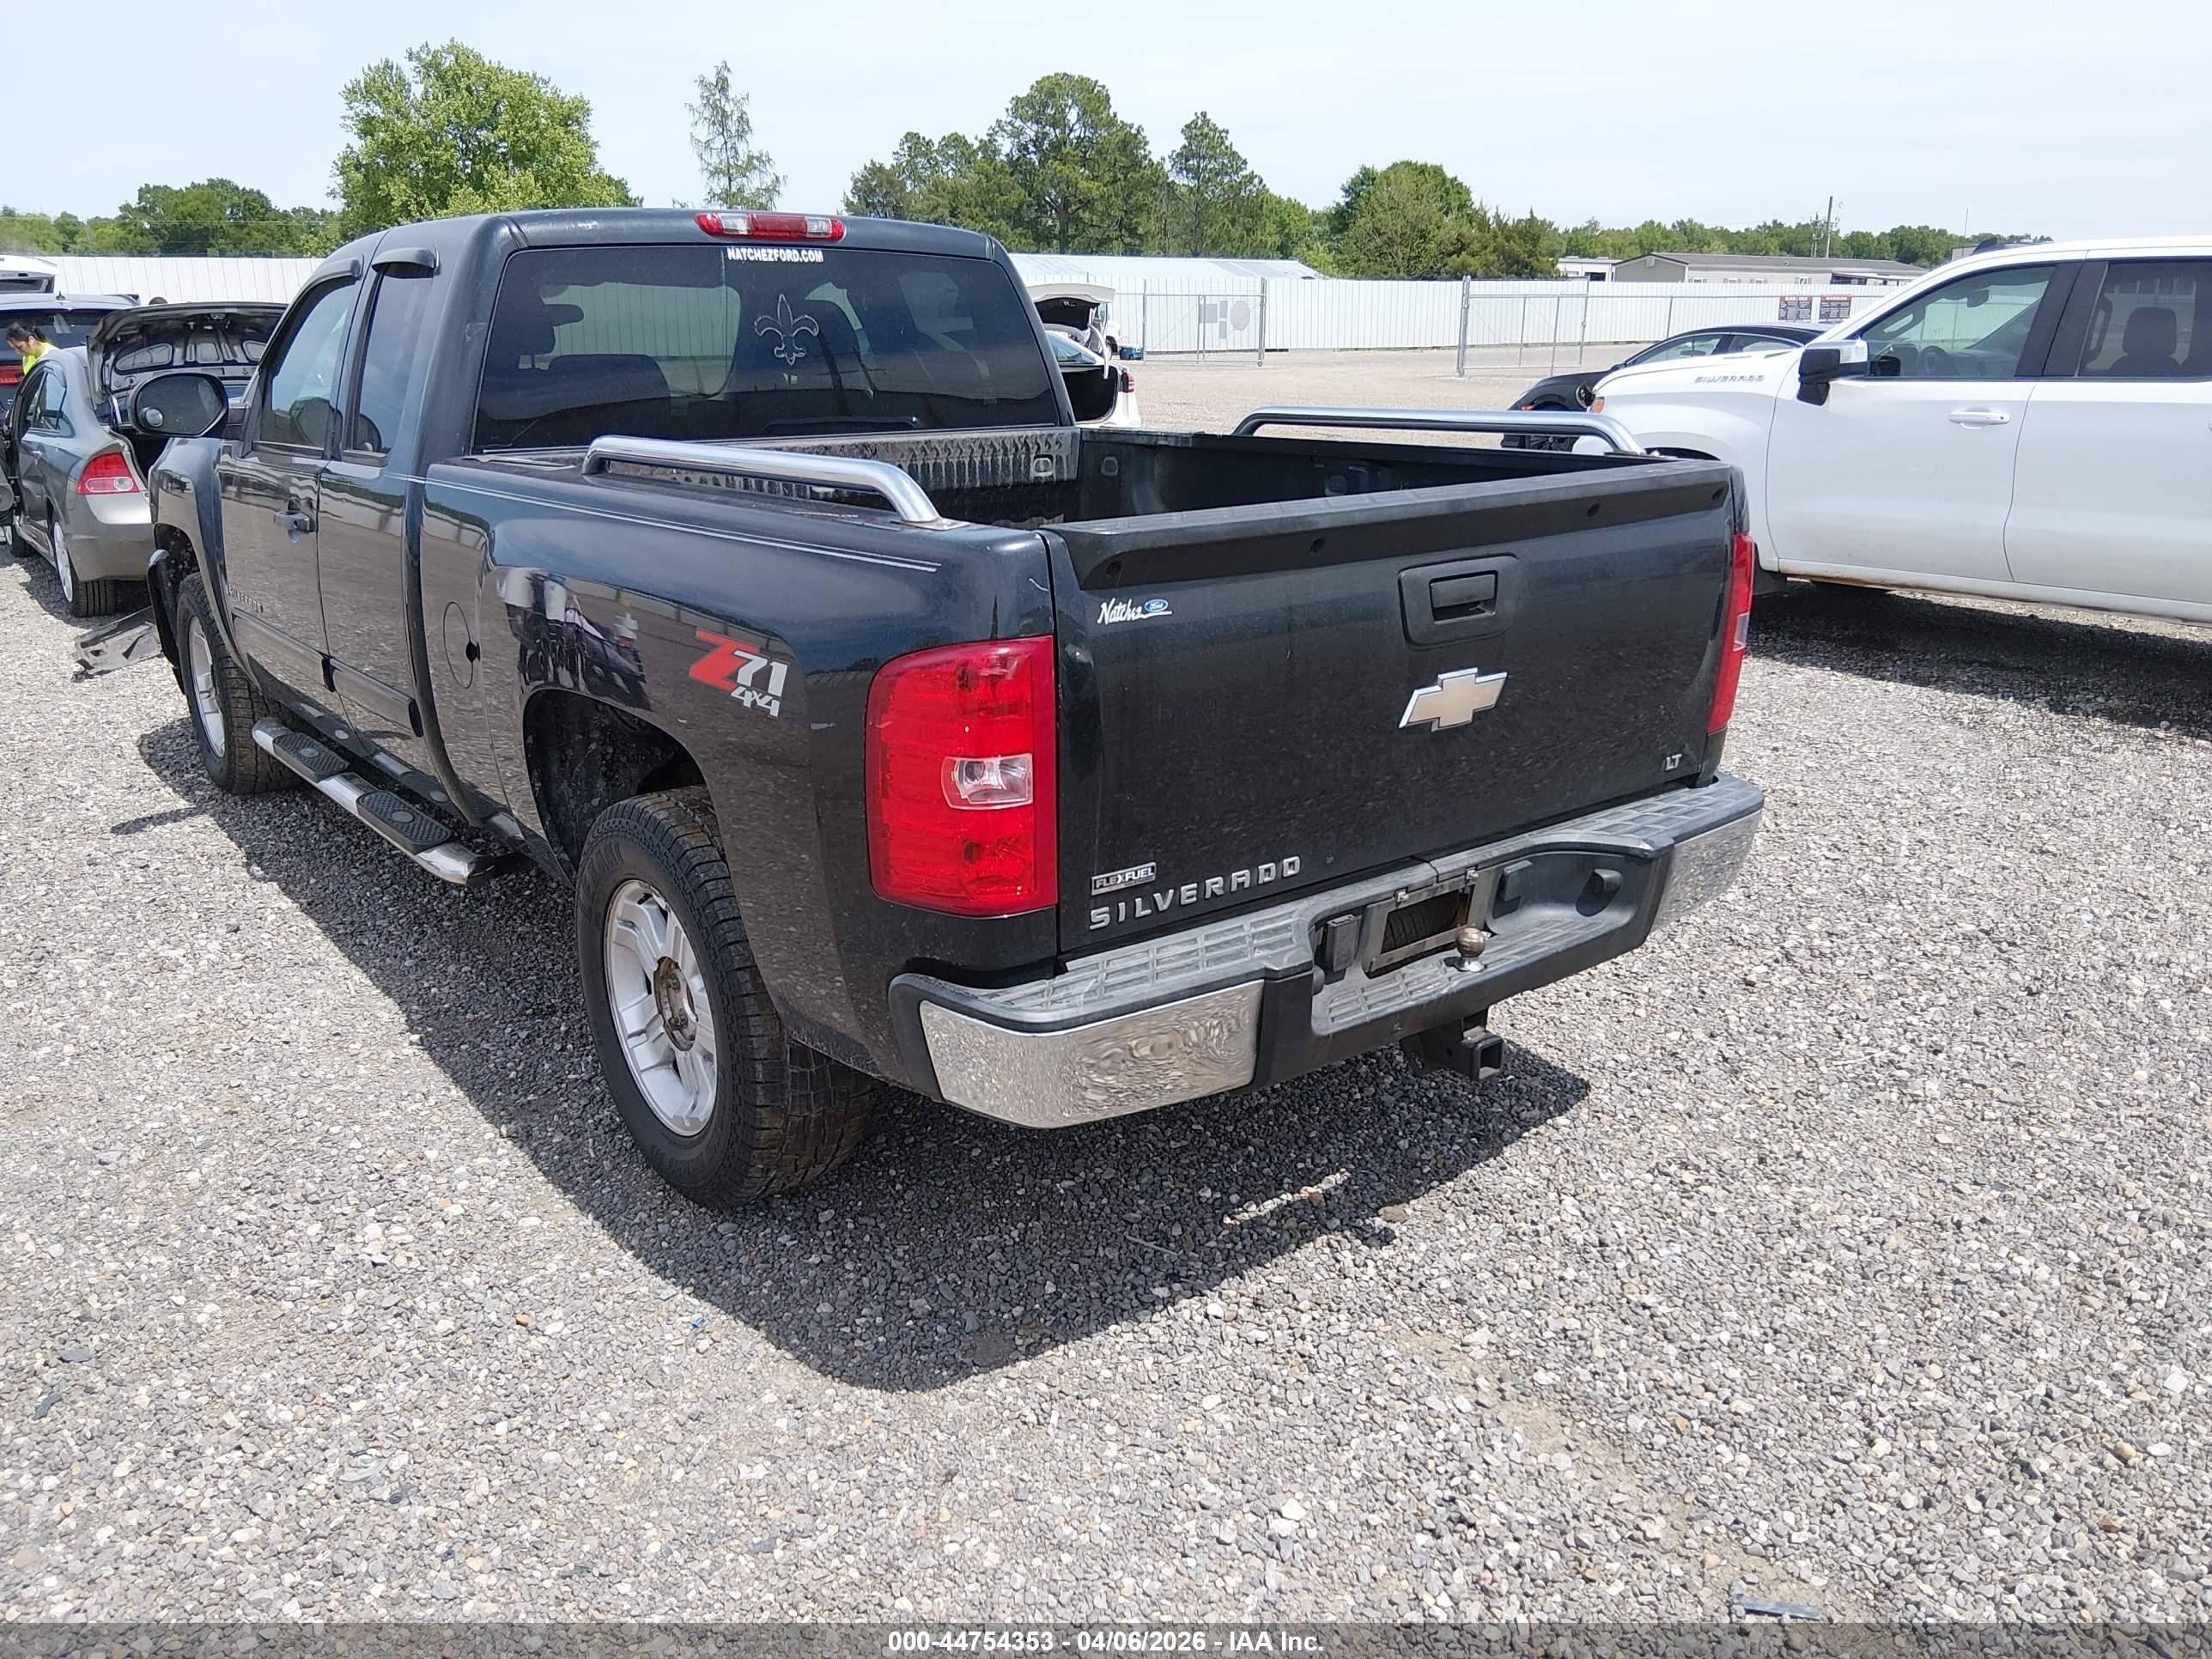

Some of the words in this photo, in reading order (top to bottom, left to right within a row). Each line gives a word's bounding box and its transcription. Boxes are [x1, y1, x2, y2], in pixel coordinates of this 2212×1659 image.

[726, 246, 824, 263] NATCHEZFORD.COM
[1097, 597, 1144, 625] Natchez
[690, 630, 788, 697] Z71
[1665, 754, 1683, 771] LT
[1095, 866, 1155, 889] FLEXFUEL
[1089, 856, 1301, 930] SILVERADO
